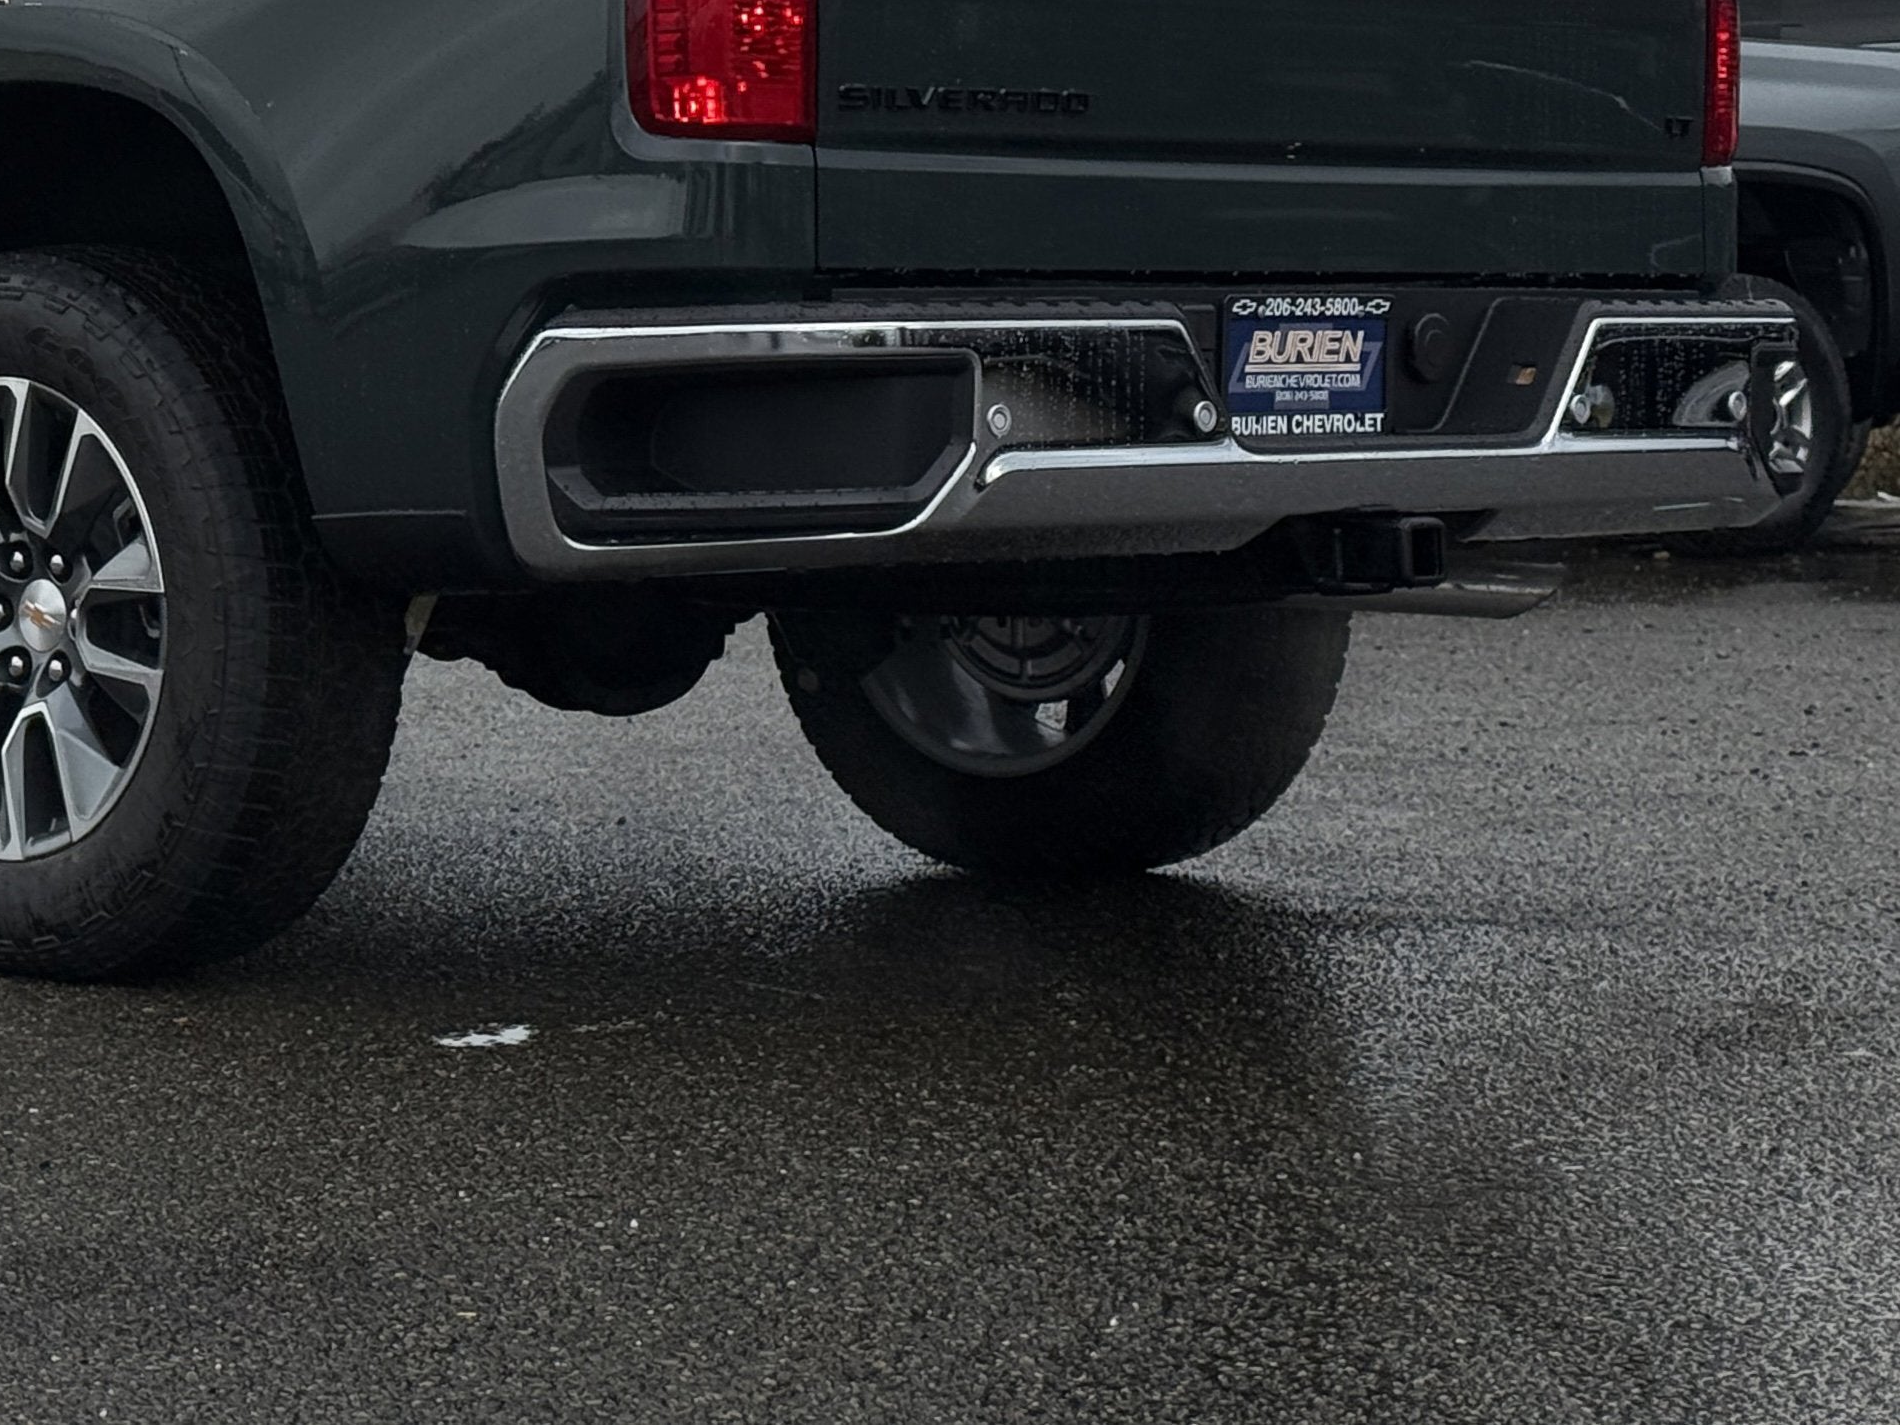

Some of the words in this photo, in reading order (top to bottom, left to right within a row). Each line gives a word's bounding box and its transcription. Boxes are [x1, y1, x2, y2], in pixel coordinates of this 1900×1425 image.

[838, 83, 1090, 113] SILVERADO
[1665, 116, 1694, 137] LT
[1264, 297, 1359, 316] 206-243-5800
[1249, 330, 1364, 363] BURIEN
